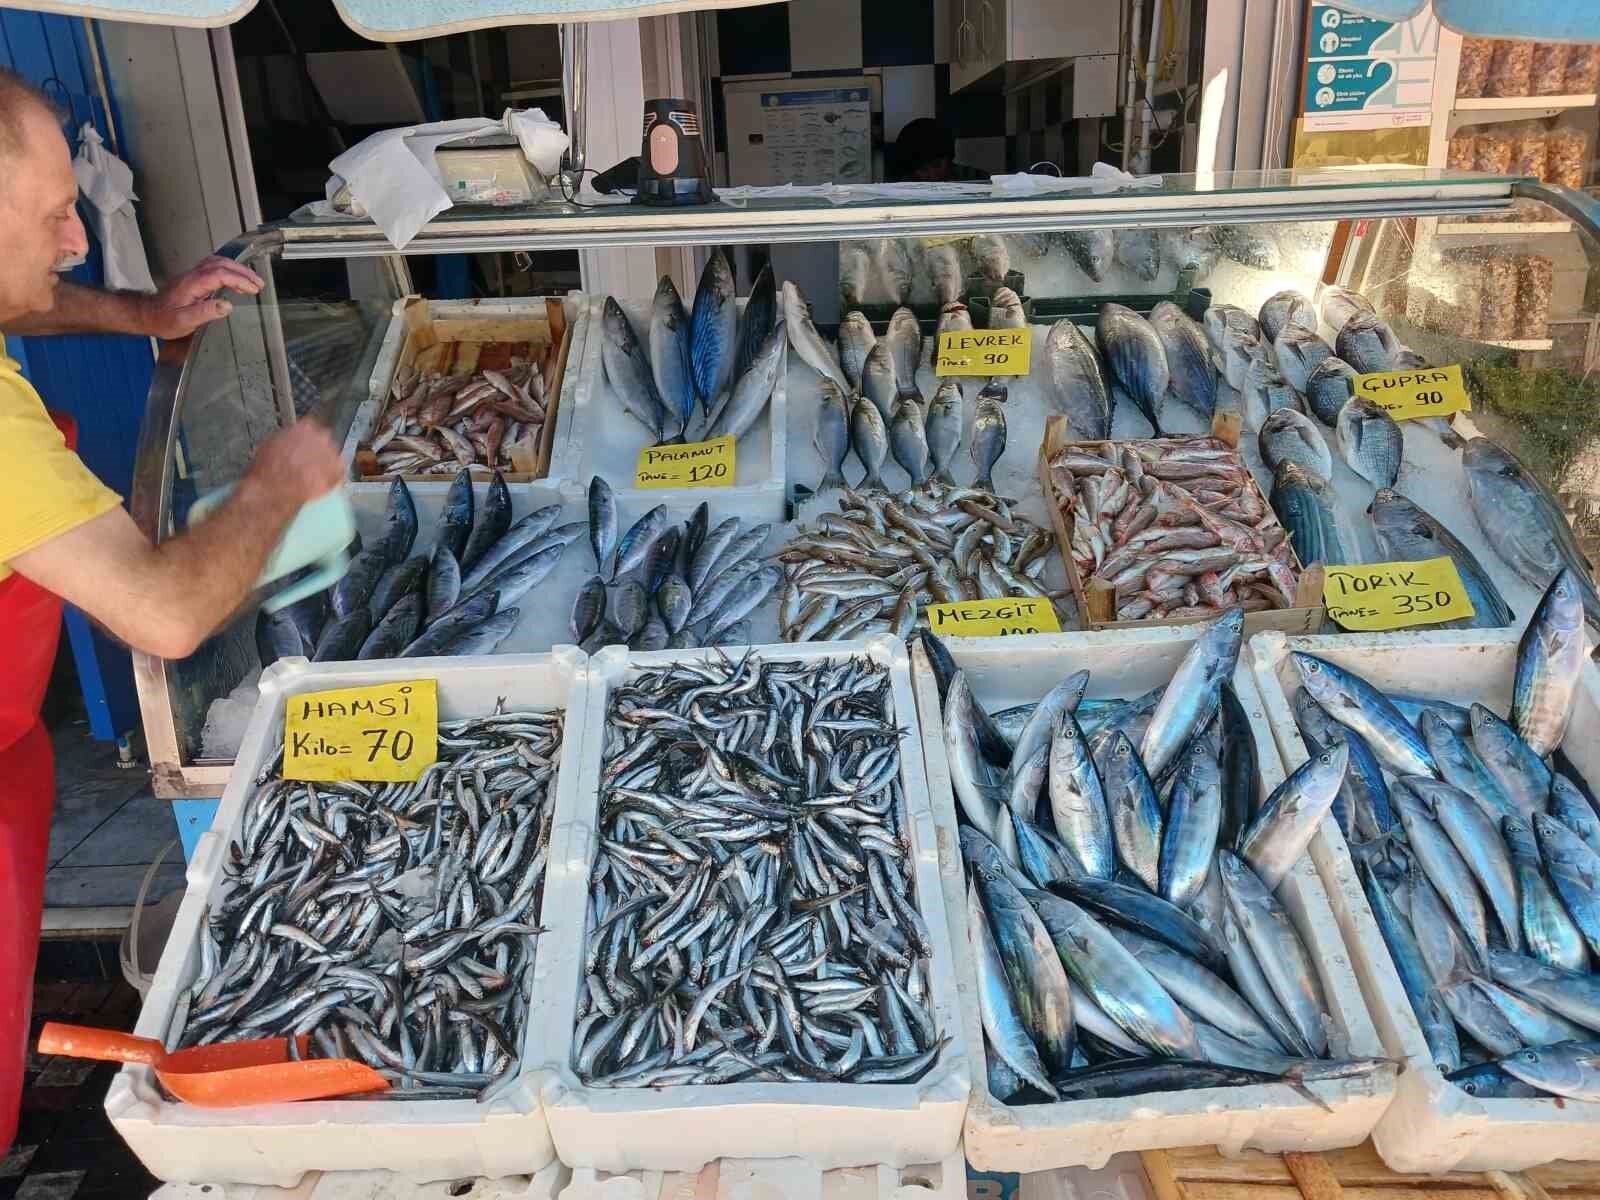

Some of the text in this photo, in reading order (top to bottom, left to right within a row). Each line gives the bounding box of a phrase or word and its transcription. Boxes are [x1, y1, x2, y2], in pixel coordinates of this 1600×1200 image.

[947, 335, 1024, 350] LEVREK
[984, 353, 1009, 365] 90
[1415, 391, 1443, 405] 90
[646, 444, 729, 464] PALAMUT
[687, 463, 728, 483] 120
[1392, 591, 1452, 615] 350
[361, 728, 414, 762] 70
